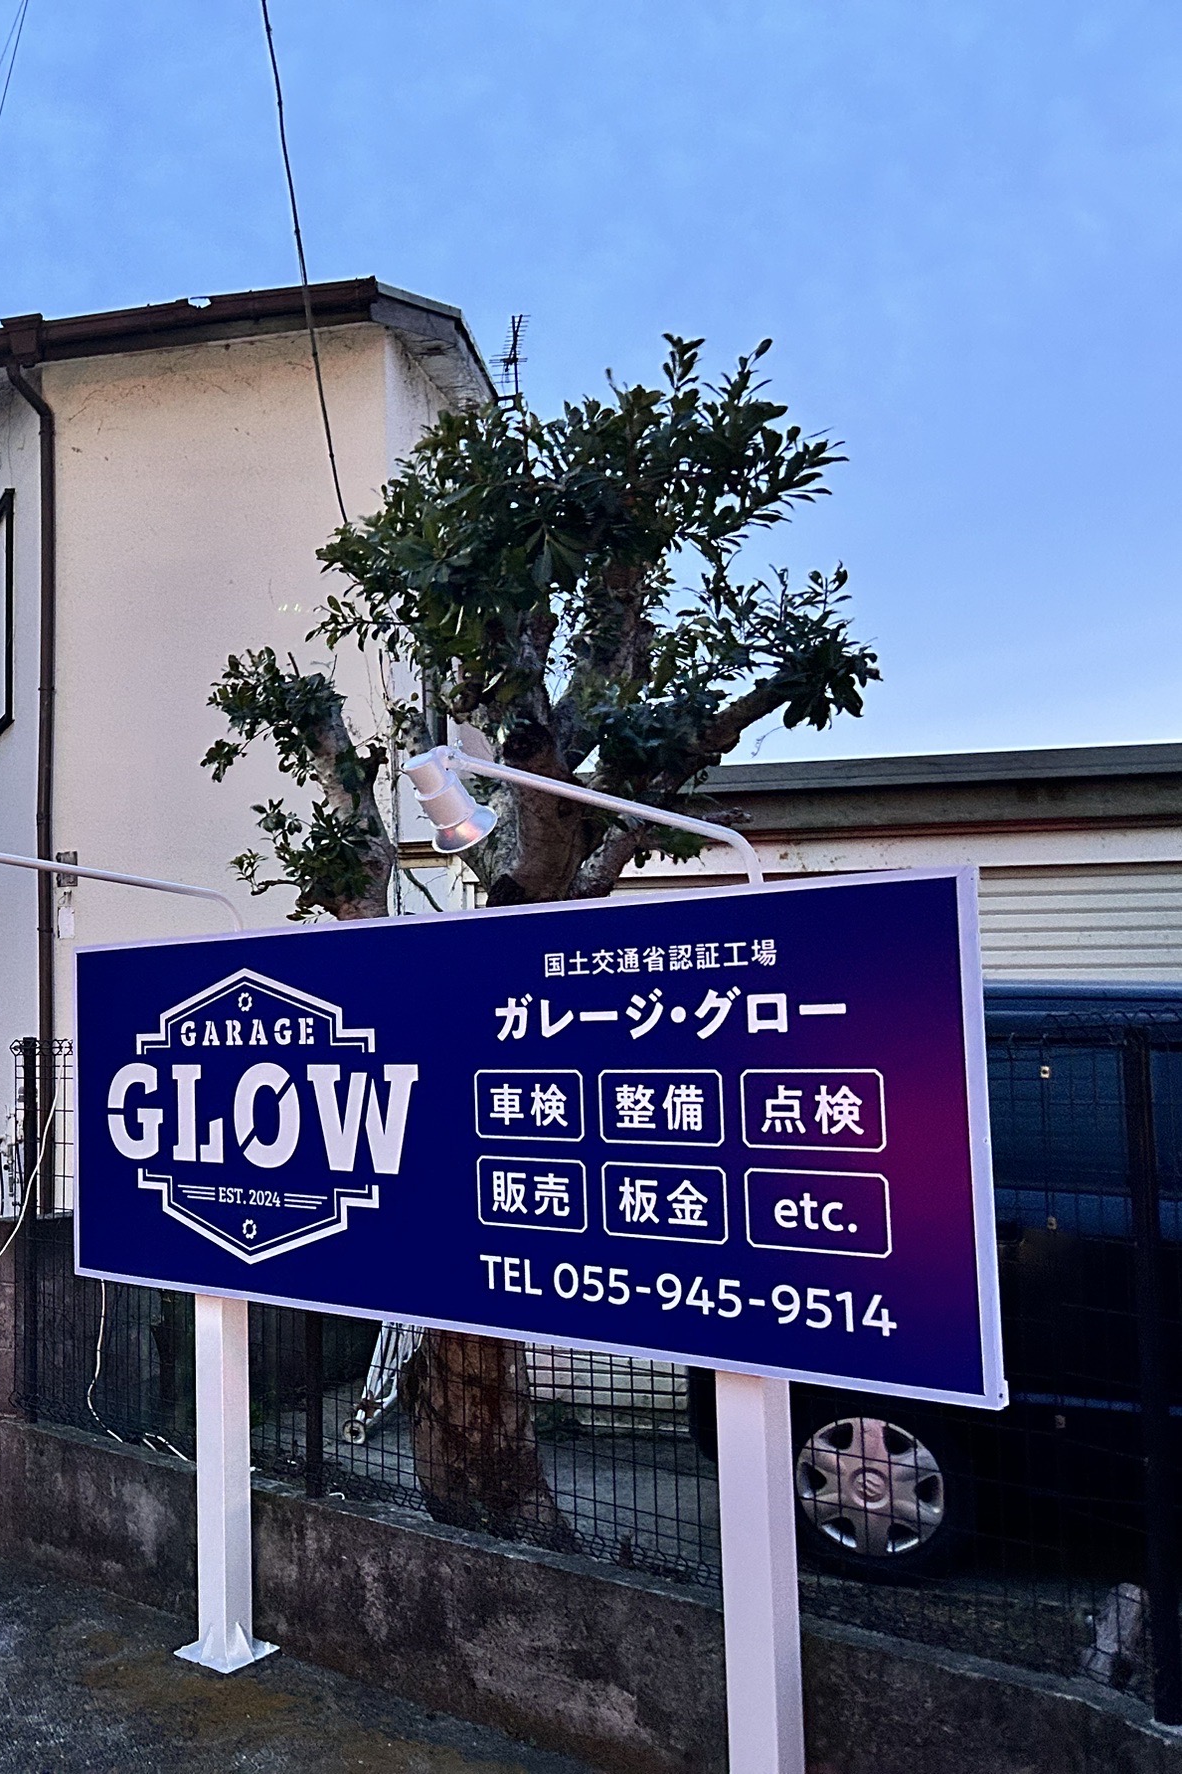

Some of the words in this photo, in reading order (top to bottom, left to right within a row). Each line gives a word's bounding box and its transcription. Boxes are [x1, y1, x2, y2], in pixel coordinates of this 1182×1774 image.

[544, 938, 777, 978] 国土交通省認証工場
[180, 1017, 315, 1047] GARAGE
[107, 1062, 419, 1175] GLOW
[489, 1083, 569, 1127] 車検
[615, 1084, 705, 1132] 整備
[760, 1084, 865, 1136] 点検
[218, 1186, 247, 1205] EST.
[248, 1189, 281, 1208] 2024
[492, 1170, 570, 1217] 販売
[618, 1178, 709, 1227] 板金
[774, 1192, 858, 1233] etc.
[479, 1254, 543, 1296] TEL
[553, 1262, 898, 1337] 055-945-9514
